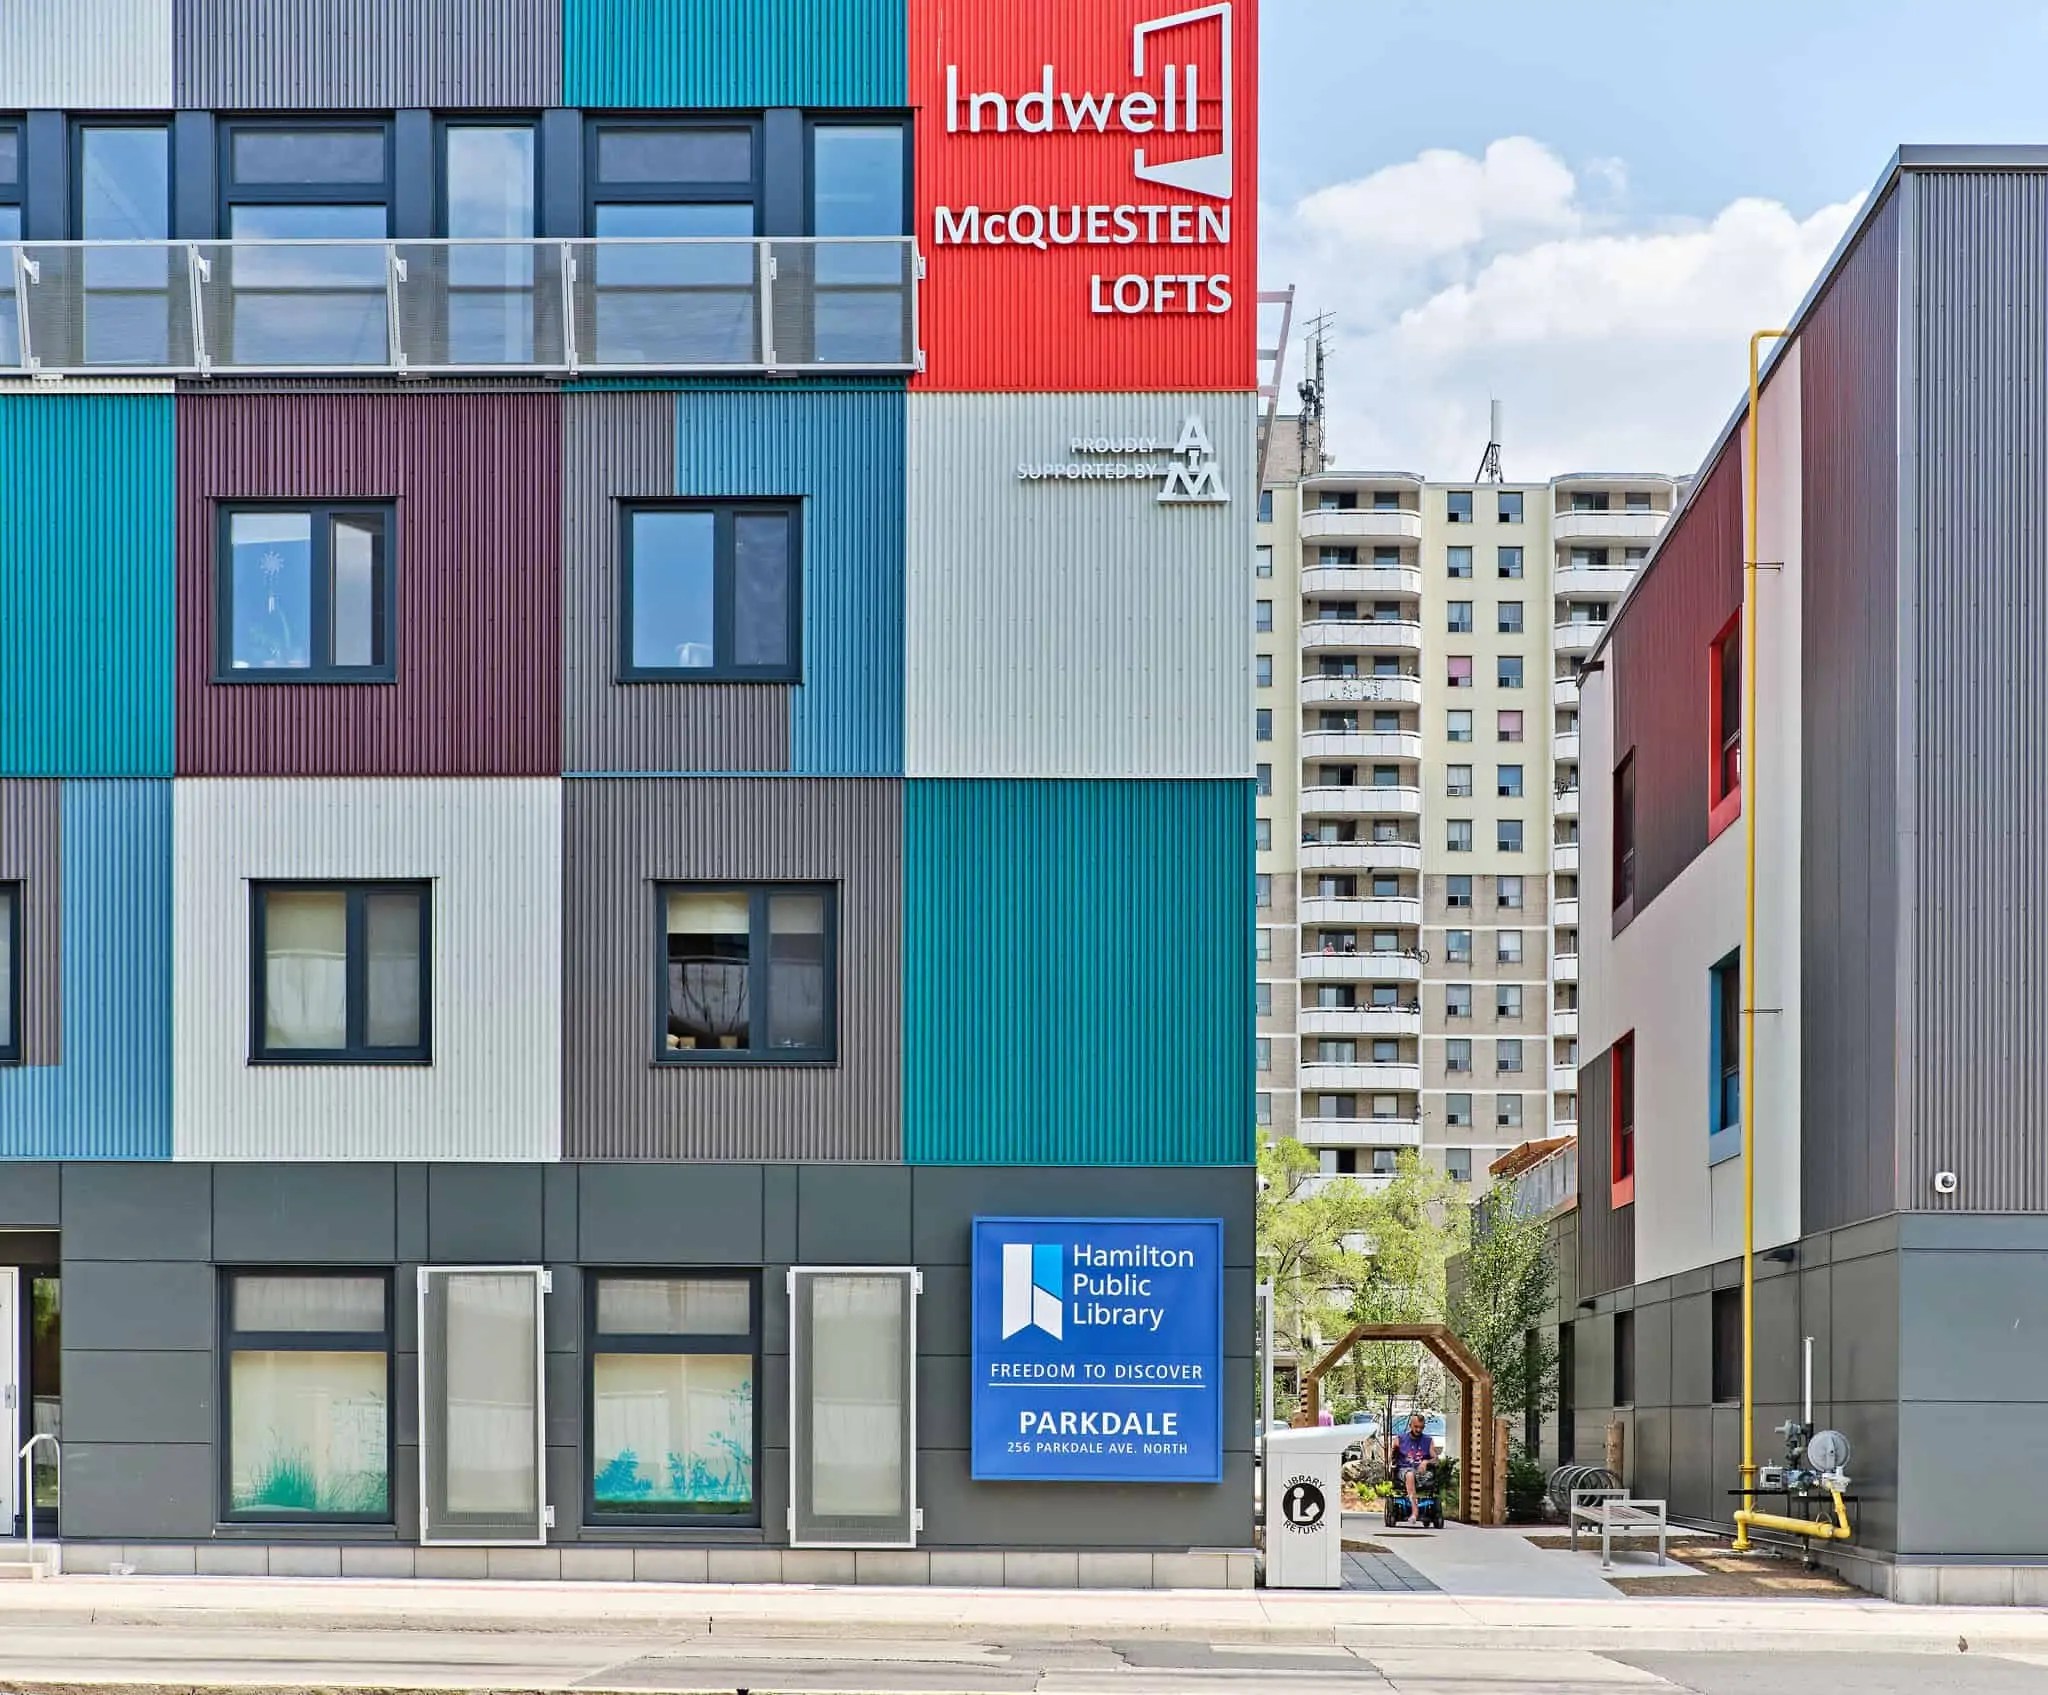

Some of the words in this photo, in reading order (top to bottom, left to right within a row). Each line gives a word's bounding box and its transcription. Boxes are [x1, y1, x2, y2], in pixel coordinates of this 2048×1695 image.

[946, 64, 1197, 133] Indwell
[935, 205, 1231, 250] McQUESTEN
[1091, 274, 1232, 313] LOFTS
[1070, 437, 1157, 453] PROUDLY
[1017, 463, 1128, 479] SUPPORTED
[1134, 464, 1158, 479] BY
[1073, 1244, 1194, 1268] Hamilton
[1073, 1273, 1152, 1297] Public
[1073, 1302, 1164, 1331] Library
[991, 1364, 1075, 1378] FREEDOM
[1084, 1364, 1106, 1378] TO
[1115, 1364, 1202, 1379] DISCOVER
[1020, 1411, 1178, 1436] PARKDALE
[1007, 1442, 1031, 1453] 256
[1036, 1442, 1103, 1454] PARKDALE
[1108, 1442, 1137, 1454] AVE.
[1143, 1443, 1188, 1454] NORTH
[1283, 1474, 1326, 1490] LIBRARY
[1283, 1519, 1325, 1535] RETURN
